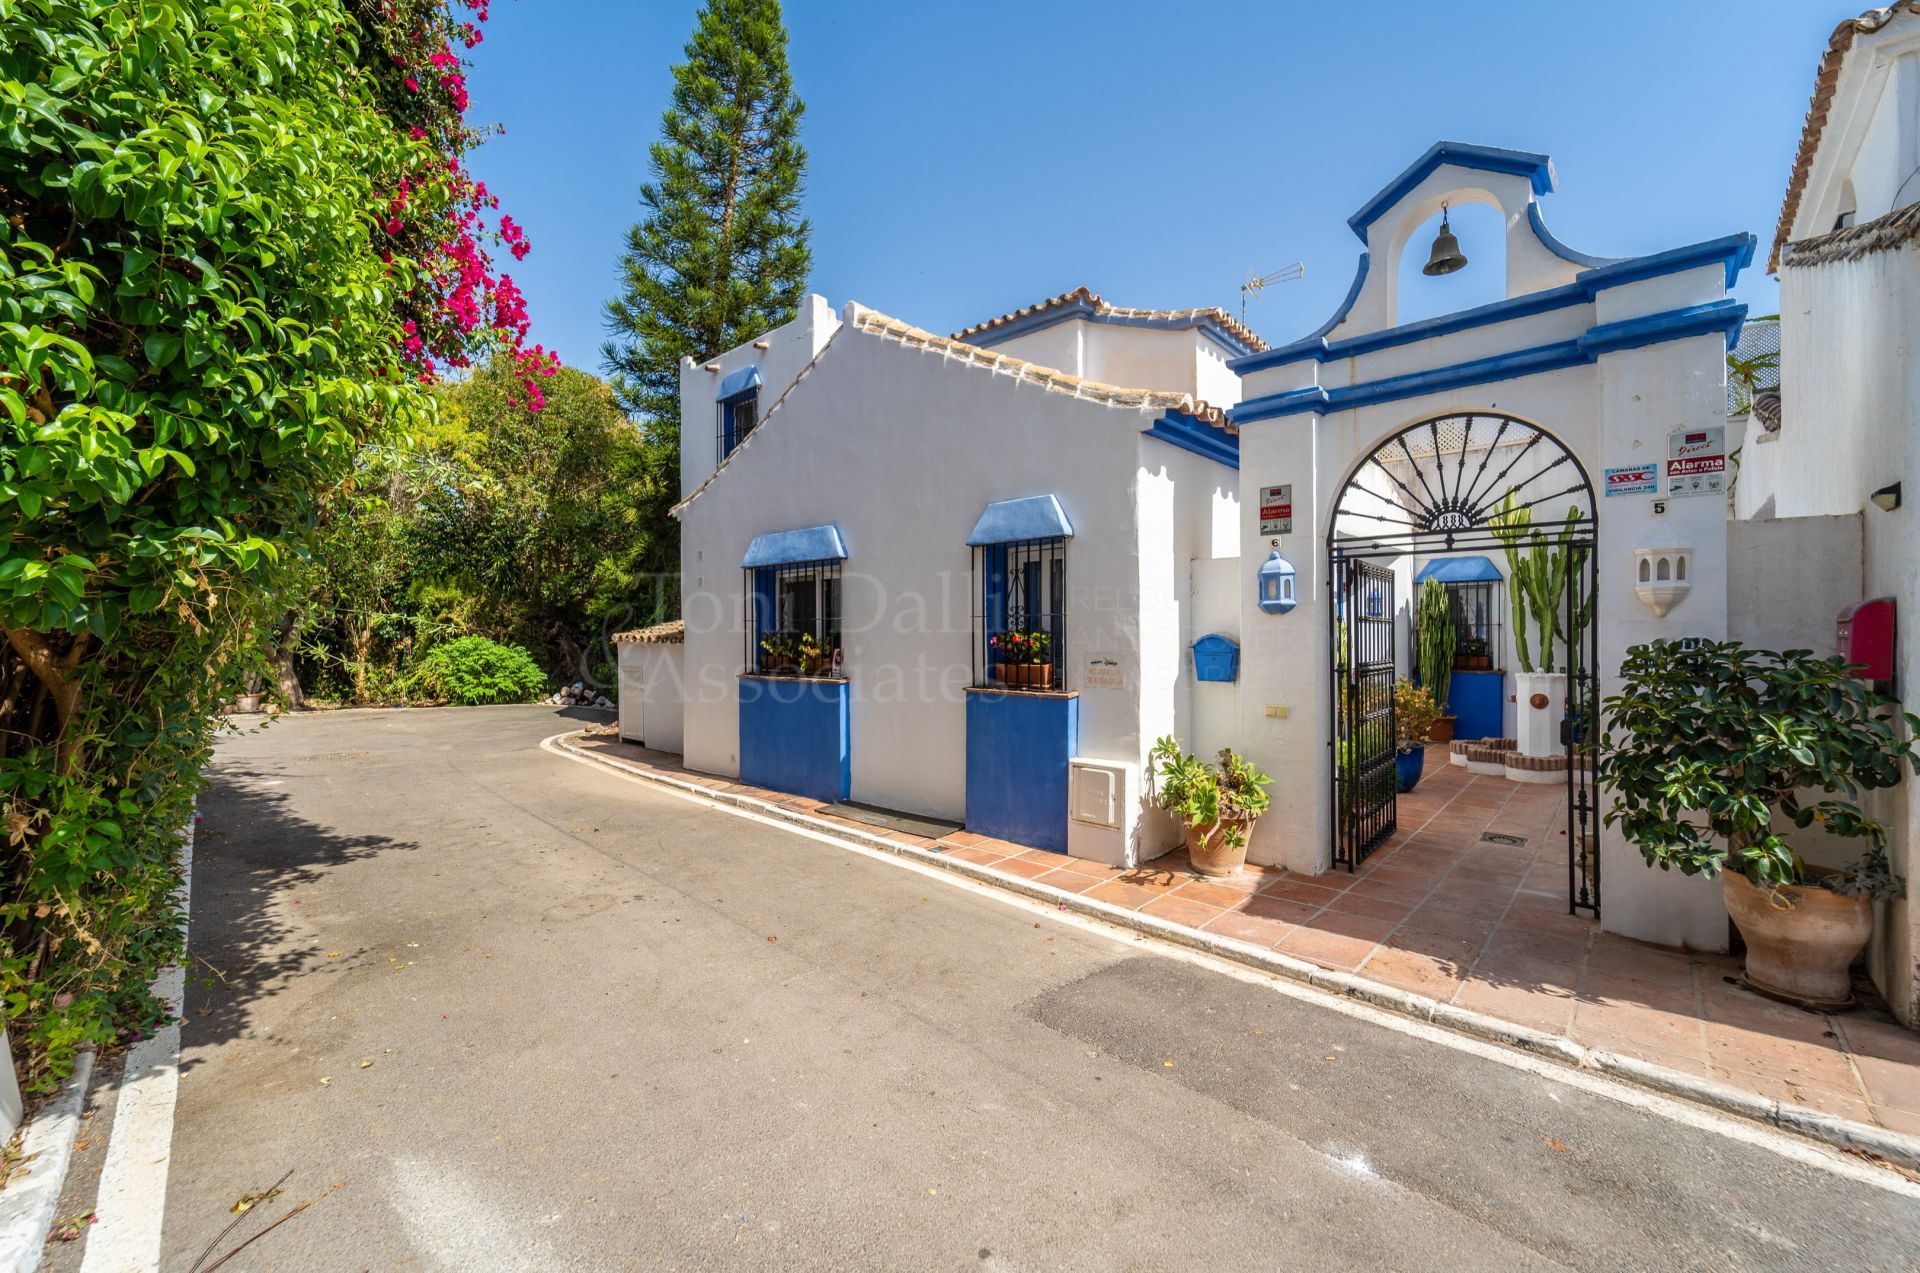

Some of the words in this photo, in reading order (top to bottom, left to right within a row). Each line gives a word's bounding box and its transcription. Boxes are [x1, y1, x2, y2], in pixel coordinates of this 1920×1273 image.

[1670, 459, 1723, 470] Alarma
[1262, 507, 1291, 516] Alarma
[1654, 502, 1666, 514] 5
[1271, 538, 1279, 548] 6
